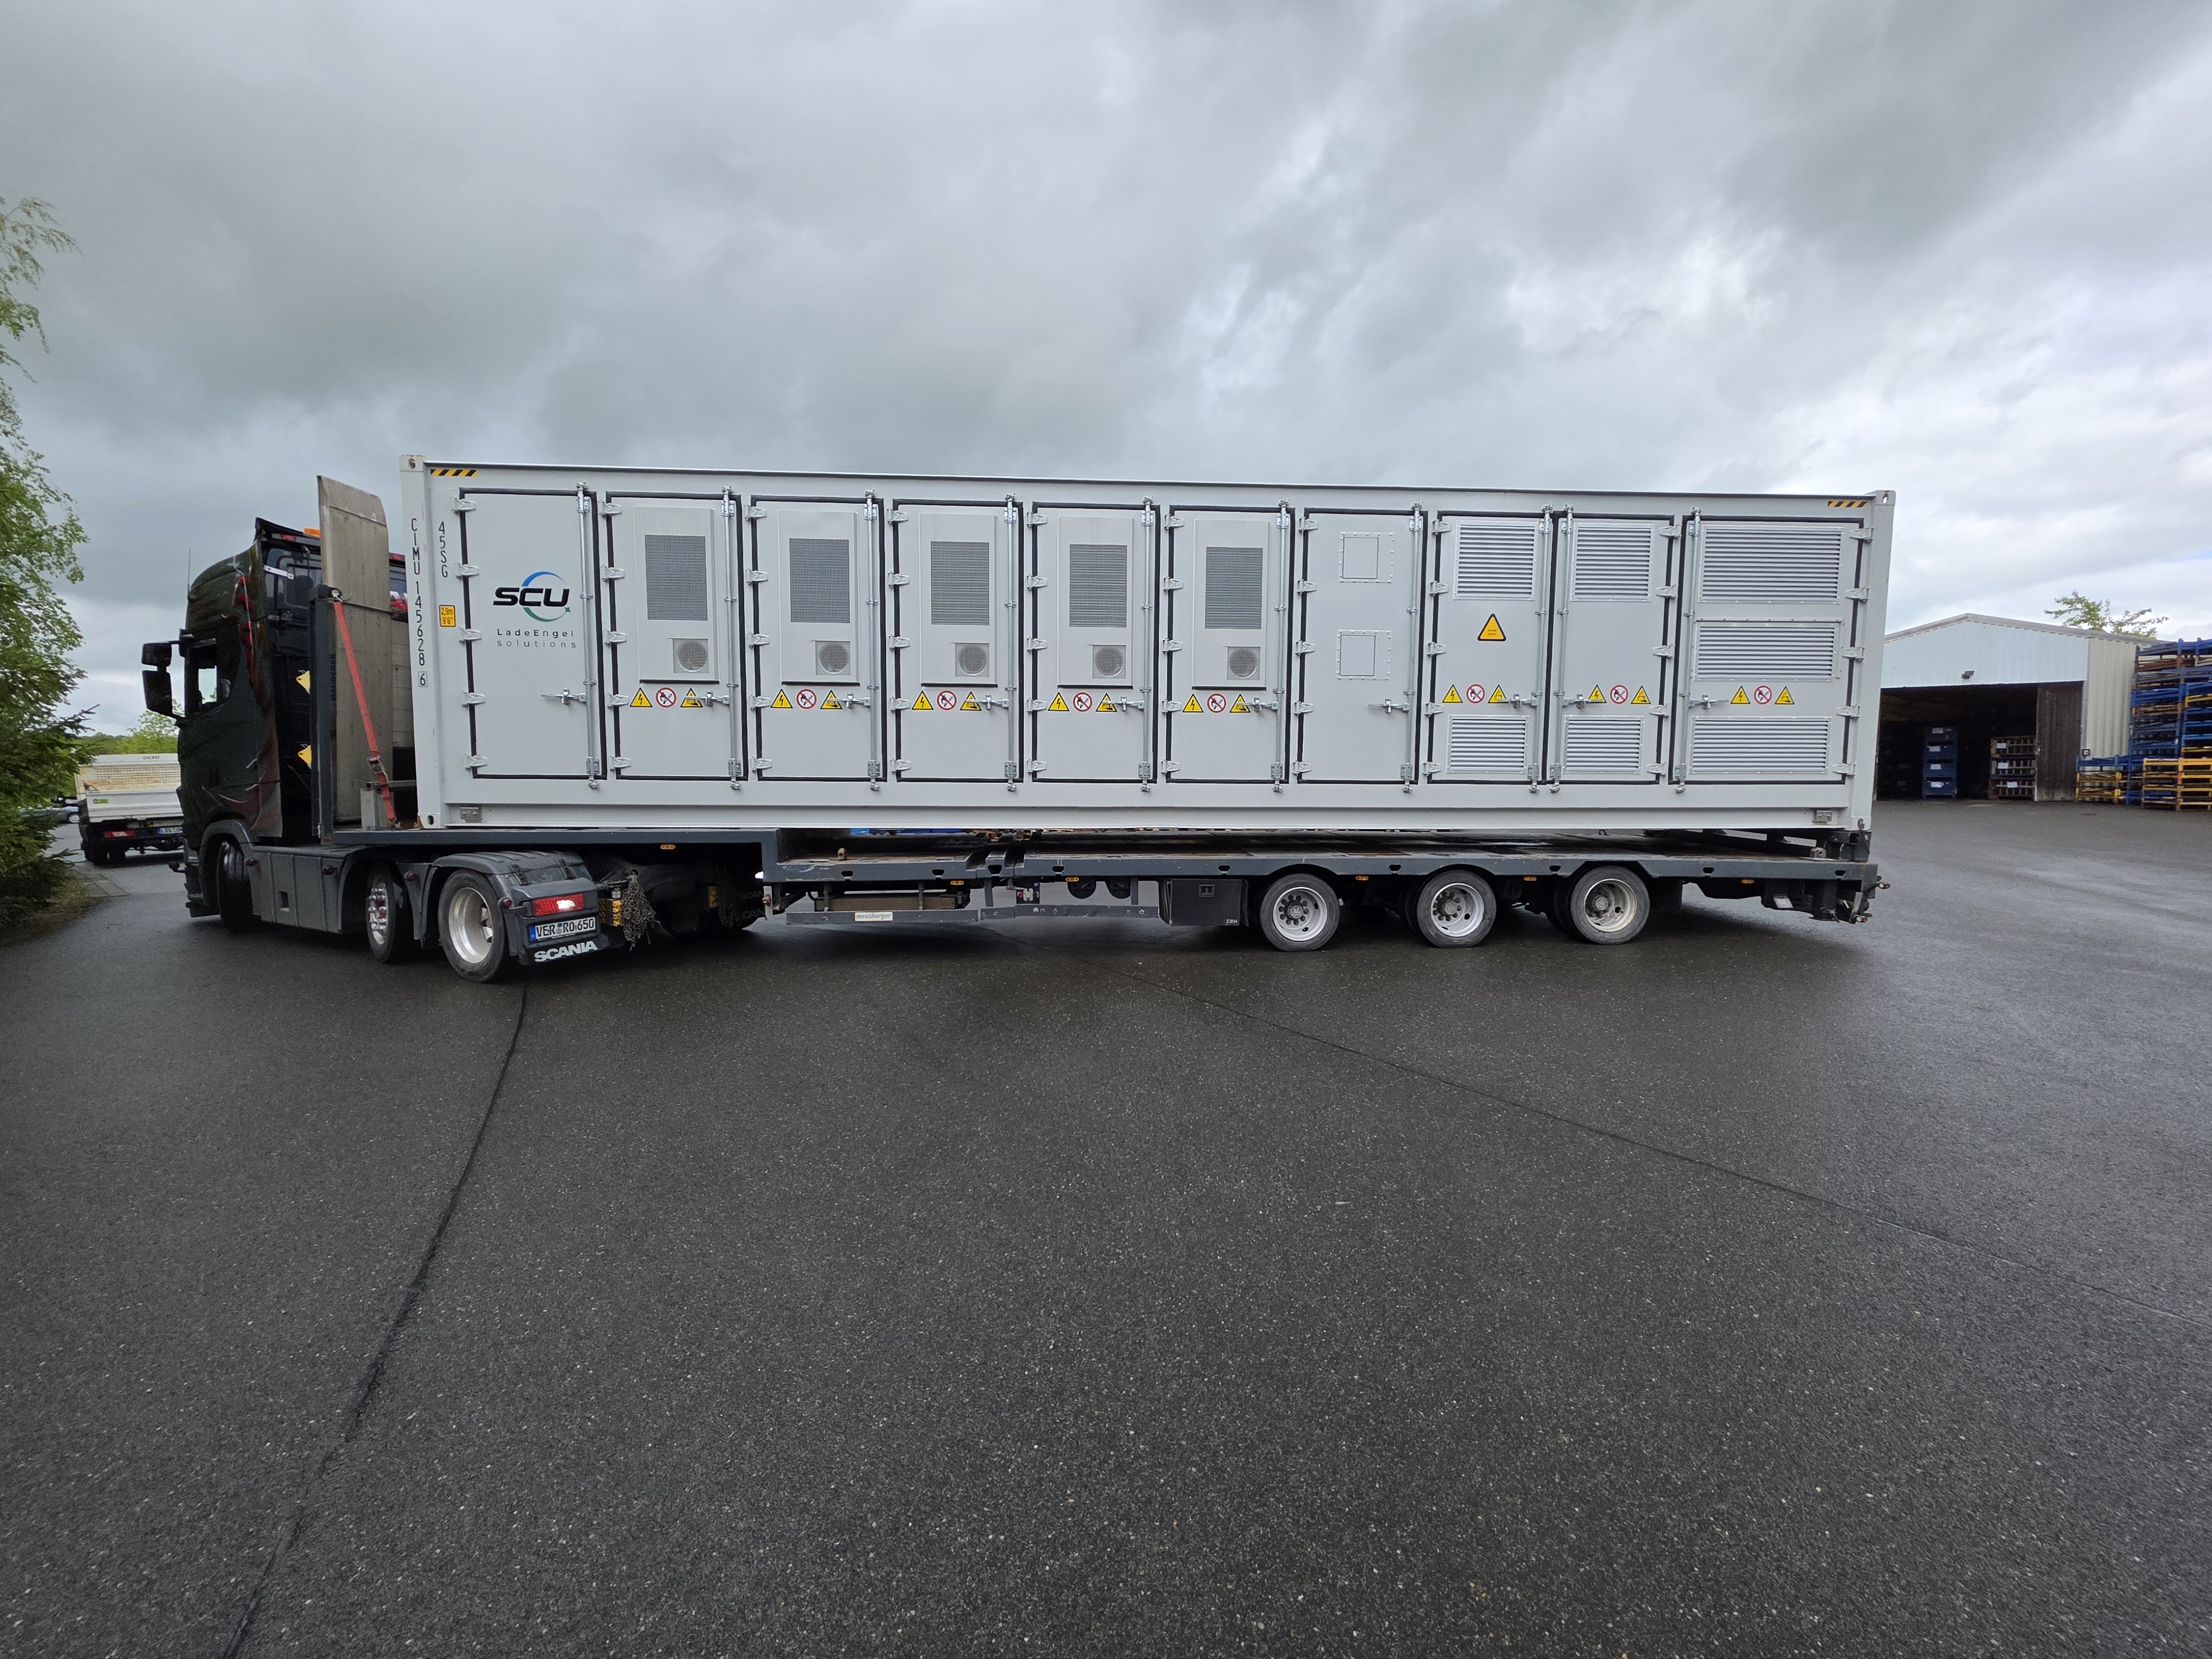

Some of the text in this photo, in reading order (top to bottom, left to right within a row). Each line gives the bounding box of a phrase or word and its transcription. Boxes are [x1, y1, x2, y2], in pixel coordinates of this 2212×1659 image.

[438, 520, 448, 578] 45SG
[411, 518, 426, 686] CIMU 145628 6
[492, 587, 570, 607] SCU
[441, 607, 453, 616] 2,9m
[497, 628, 573, 639] LadeEngel
[497, 639, 576, 649] solutions
[536, 924, 556, 937] VER
[562, 921, 575, 933] RO
[577, 918, 594, 931] 650
[534, 940, 598, 962] SCANIA
